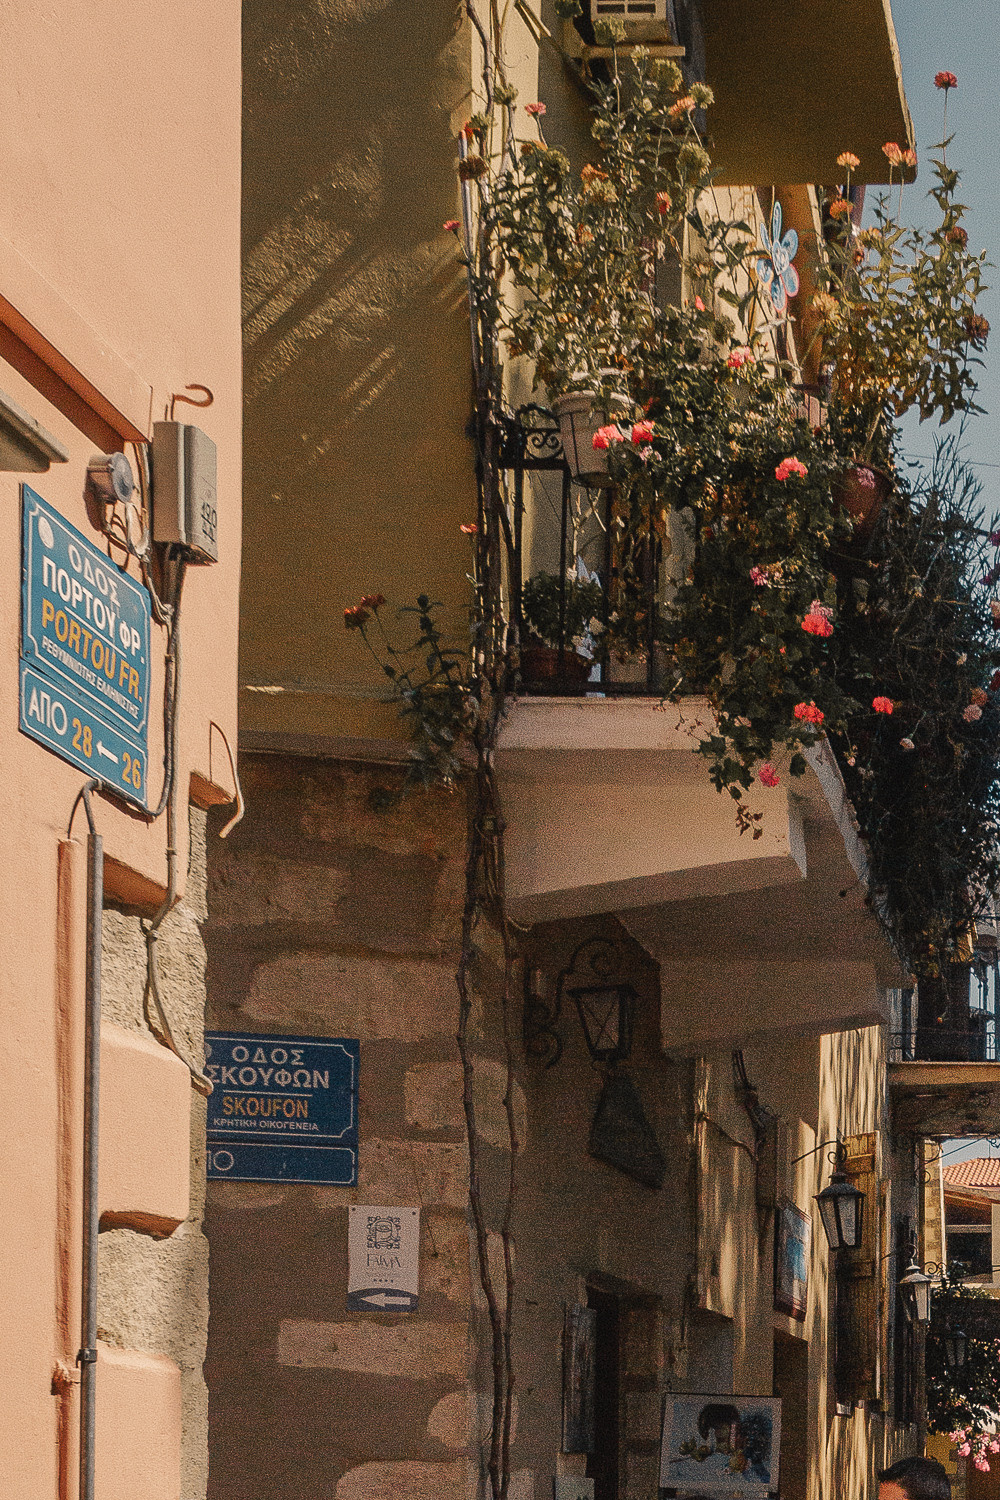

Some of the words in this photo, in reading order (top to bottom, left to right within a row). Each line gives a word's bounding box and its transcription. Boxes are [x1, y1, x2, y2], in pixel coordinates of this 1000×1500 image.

[68, 544, 120, 607] ΟΔΟΣ
[43, 555, 116, 639] ΠΟΡΤΟΥ
[119, 620, 145, 665] ΦΡ.
[42, 598, 116, 679] PORTOU
[119, 660, 143, 703] FR.
[28, 686, 68, 735] ΑΠΟ
[72, 718, 92, 759] 28
[122, 752, 141, 789] 26
[206, 1064, 329, 1089] ΣΚΟΥΦΩΝ
[232, 1046, 305, 1066] ΟΔΟΣ
[213, 1117, 257, 1128] ΚΡΗΤΙΚΗ
[259, 1119, 319, 1132] ΟΙΚΟΓΕΝΕΙΑ
[222, 1096, 309, 1118] SKOUFON
